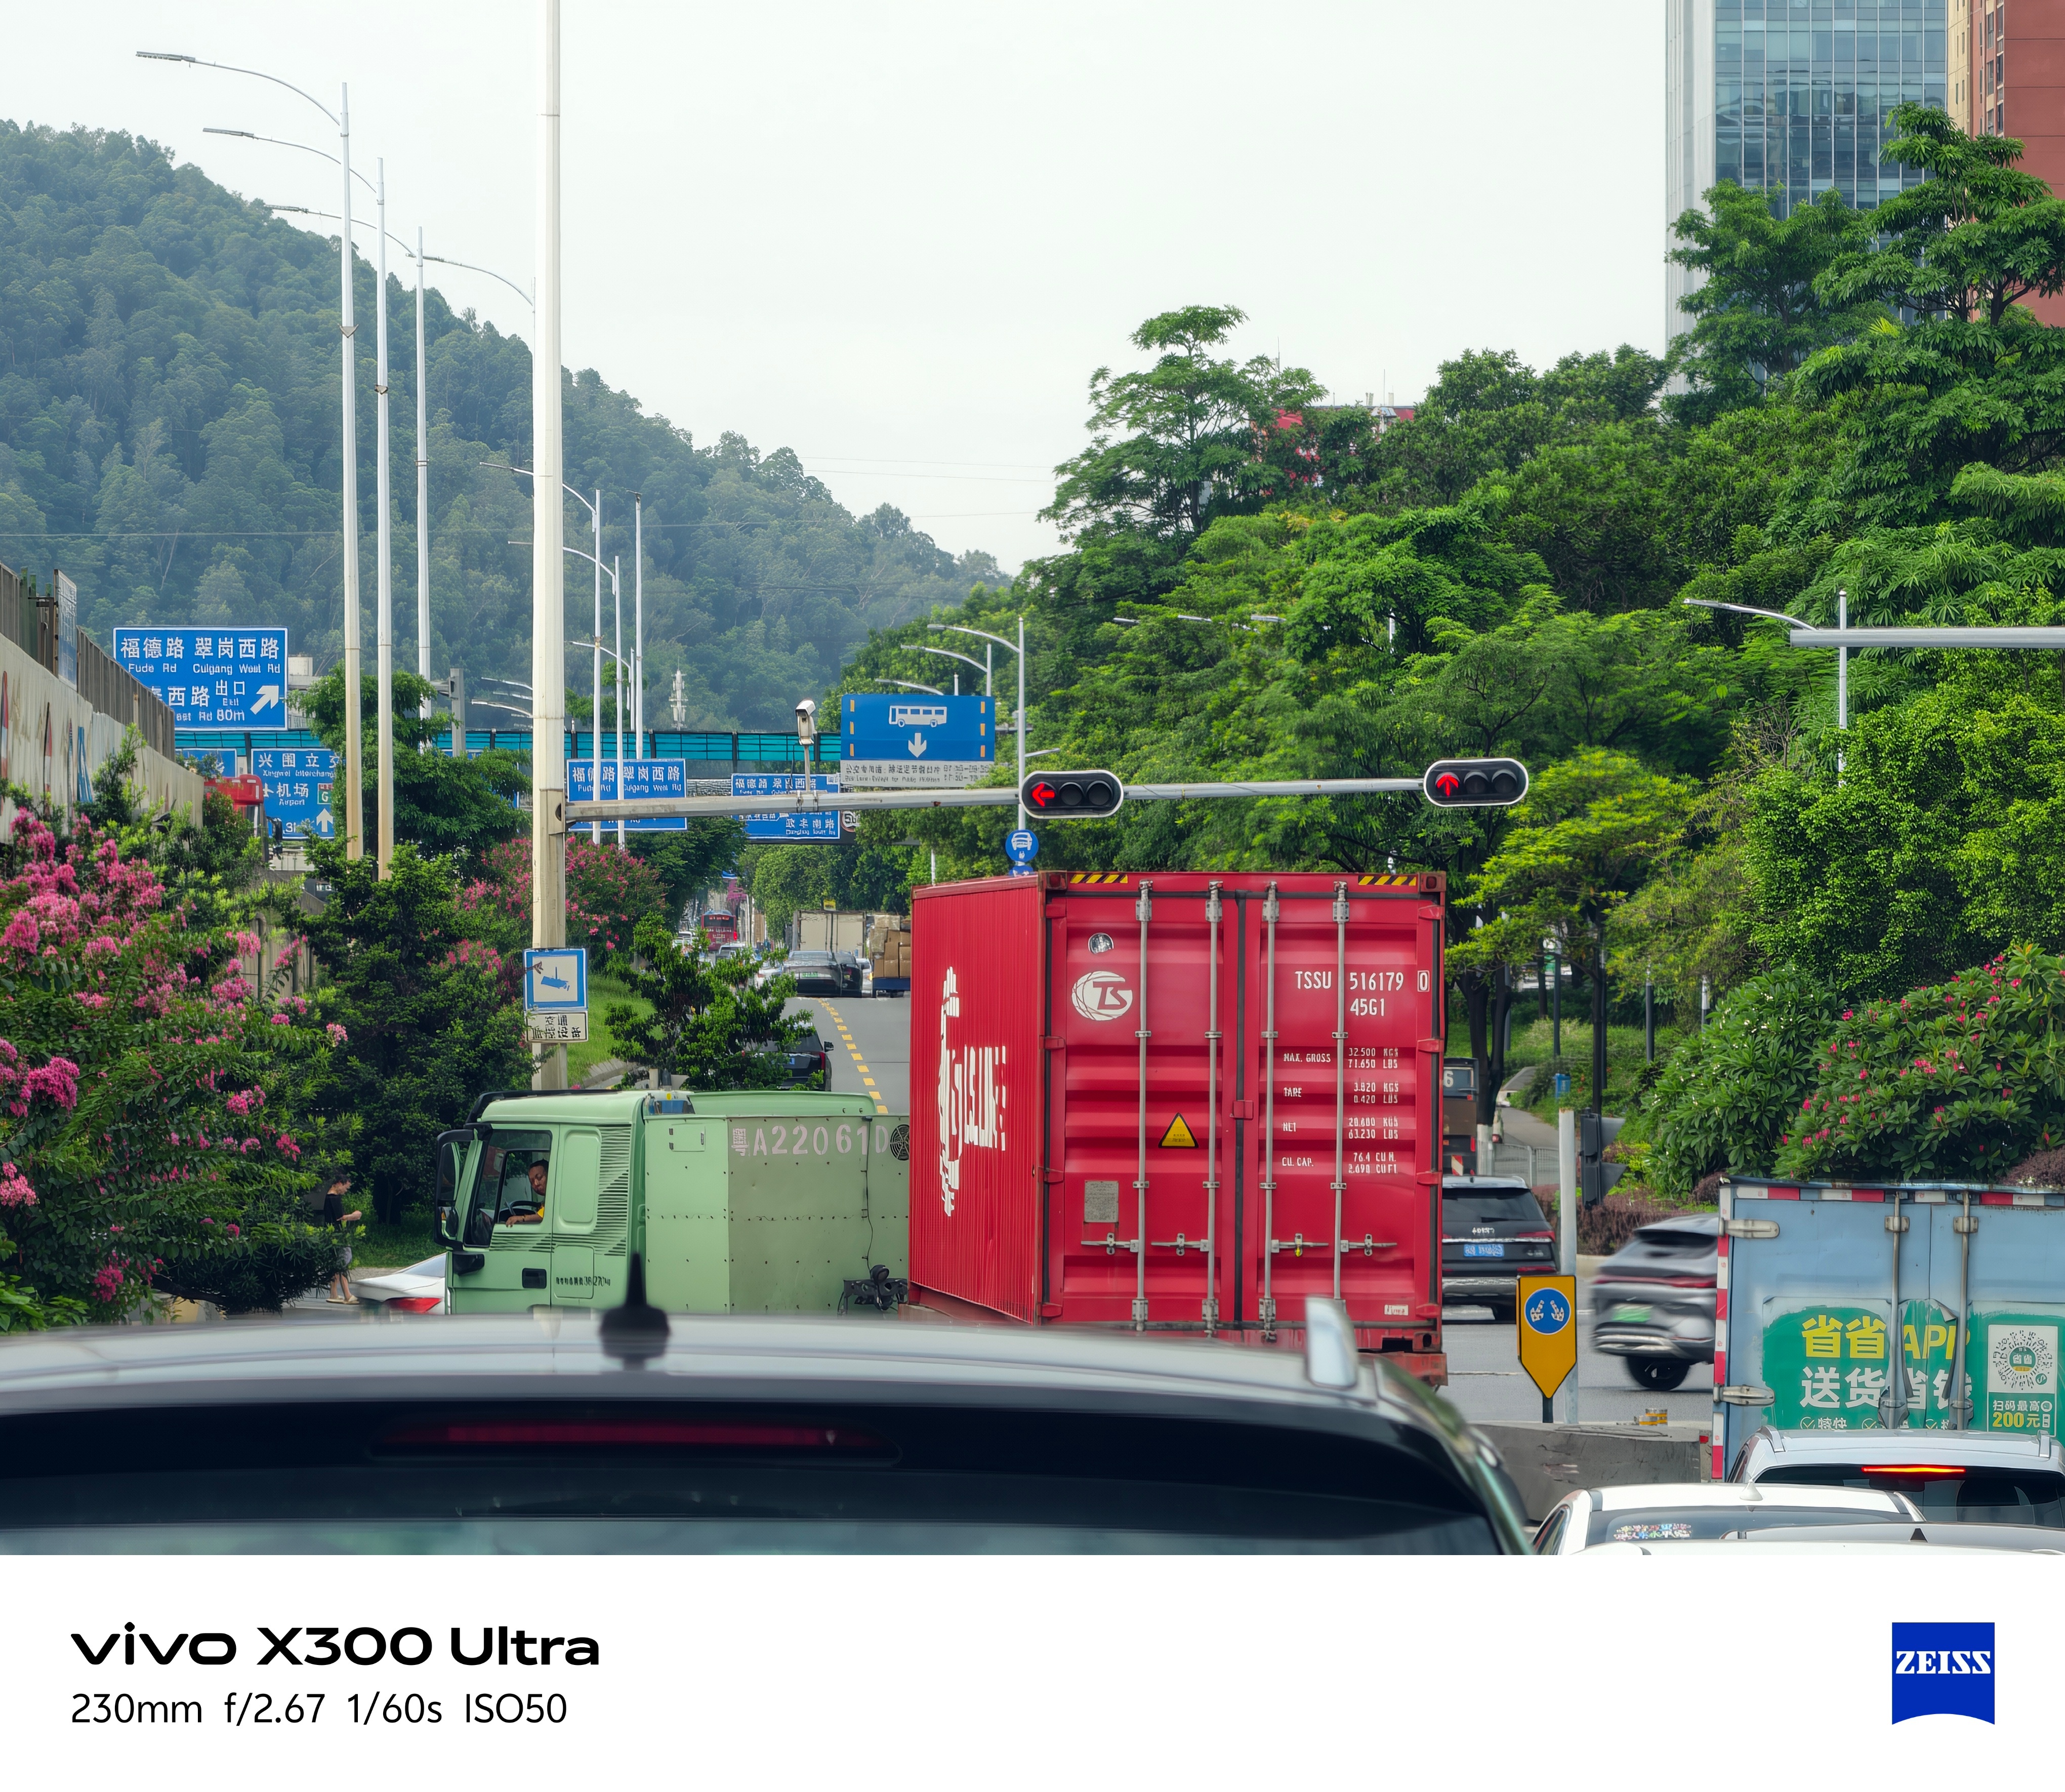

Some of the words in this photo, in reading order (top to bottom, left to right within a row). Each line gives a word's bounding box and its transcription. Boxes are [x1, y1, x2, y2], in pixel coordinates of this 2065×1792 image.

[120, 637, 184, 659] 福德路
[194, 637, 279, 659] 翠岗西路
[129, 664, 154, 673] Fude
[216, 679, 245, 696] 出口
[217, 709, 244, 721] 80m
[1295, 971, 1332, 989] TSSU
[1350, 972, 1404, 991] 516179
[1350, 998, 1384, 1016] 45G1
[1306, 1053, 1331, 1063] GROSS
[1284, 1087, 1302, 1097] TARE
[1354, 1082, 1375, 1092] 3.820
[1283, 1122, 1296, 1132] NET
[1992, 1412, 2040, 1428] 200元
